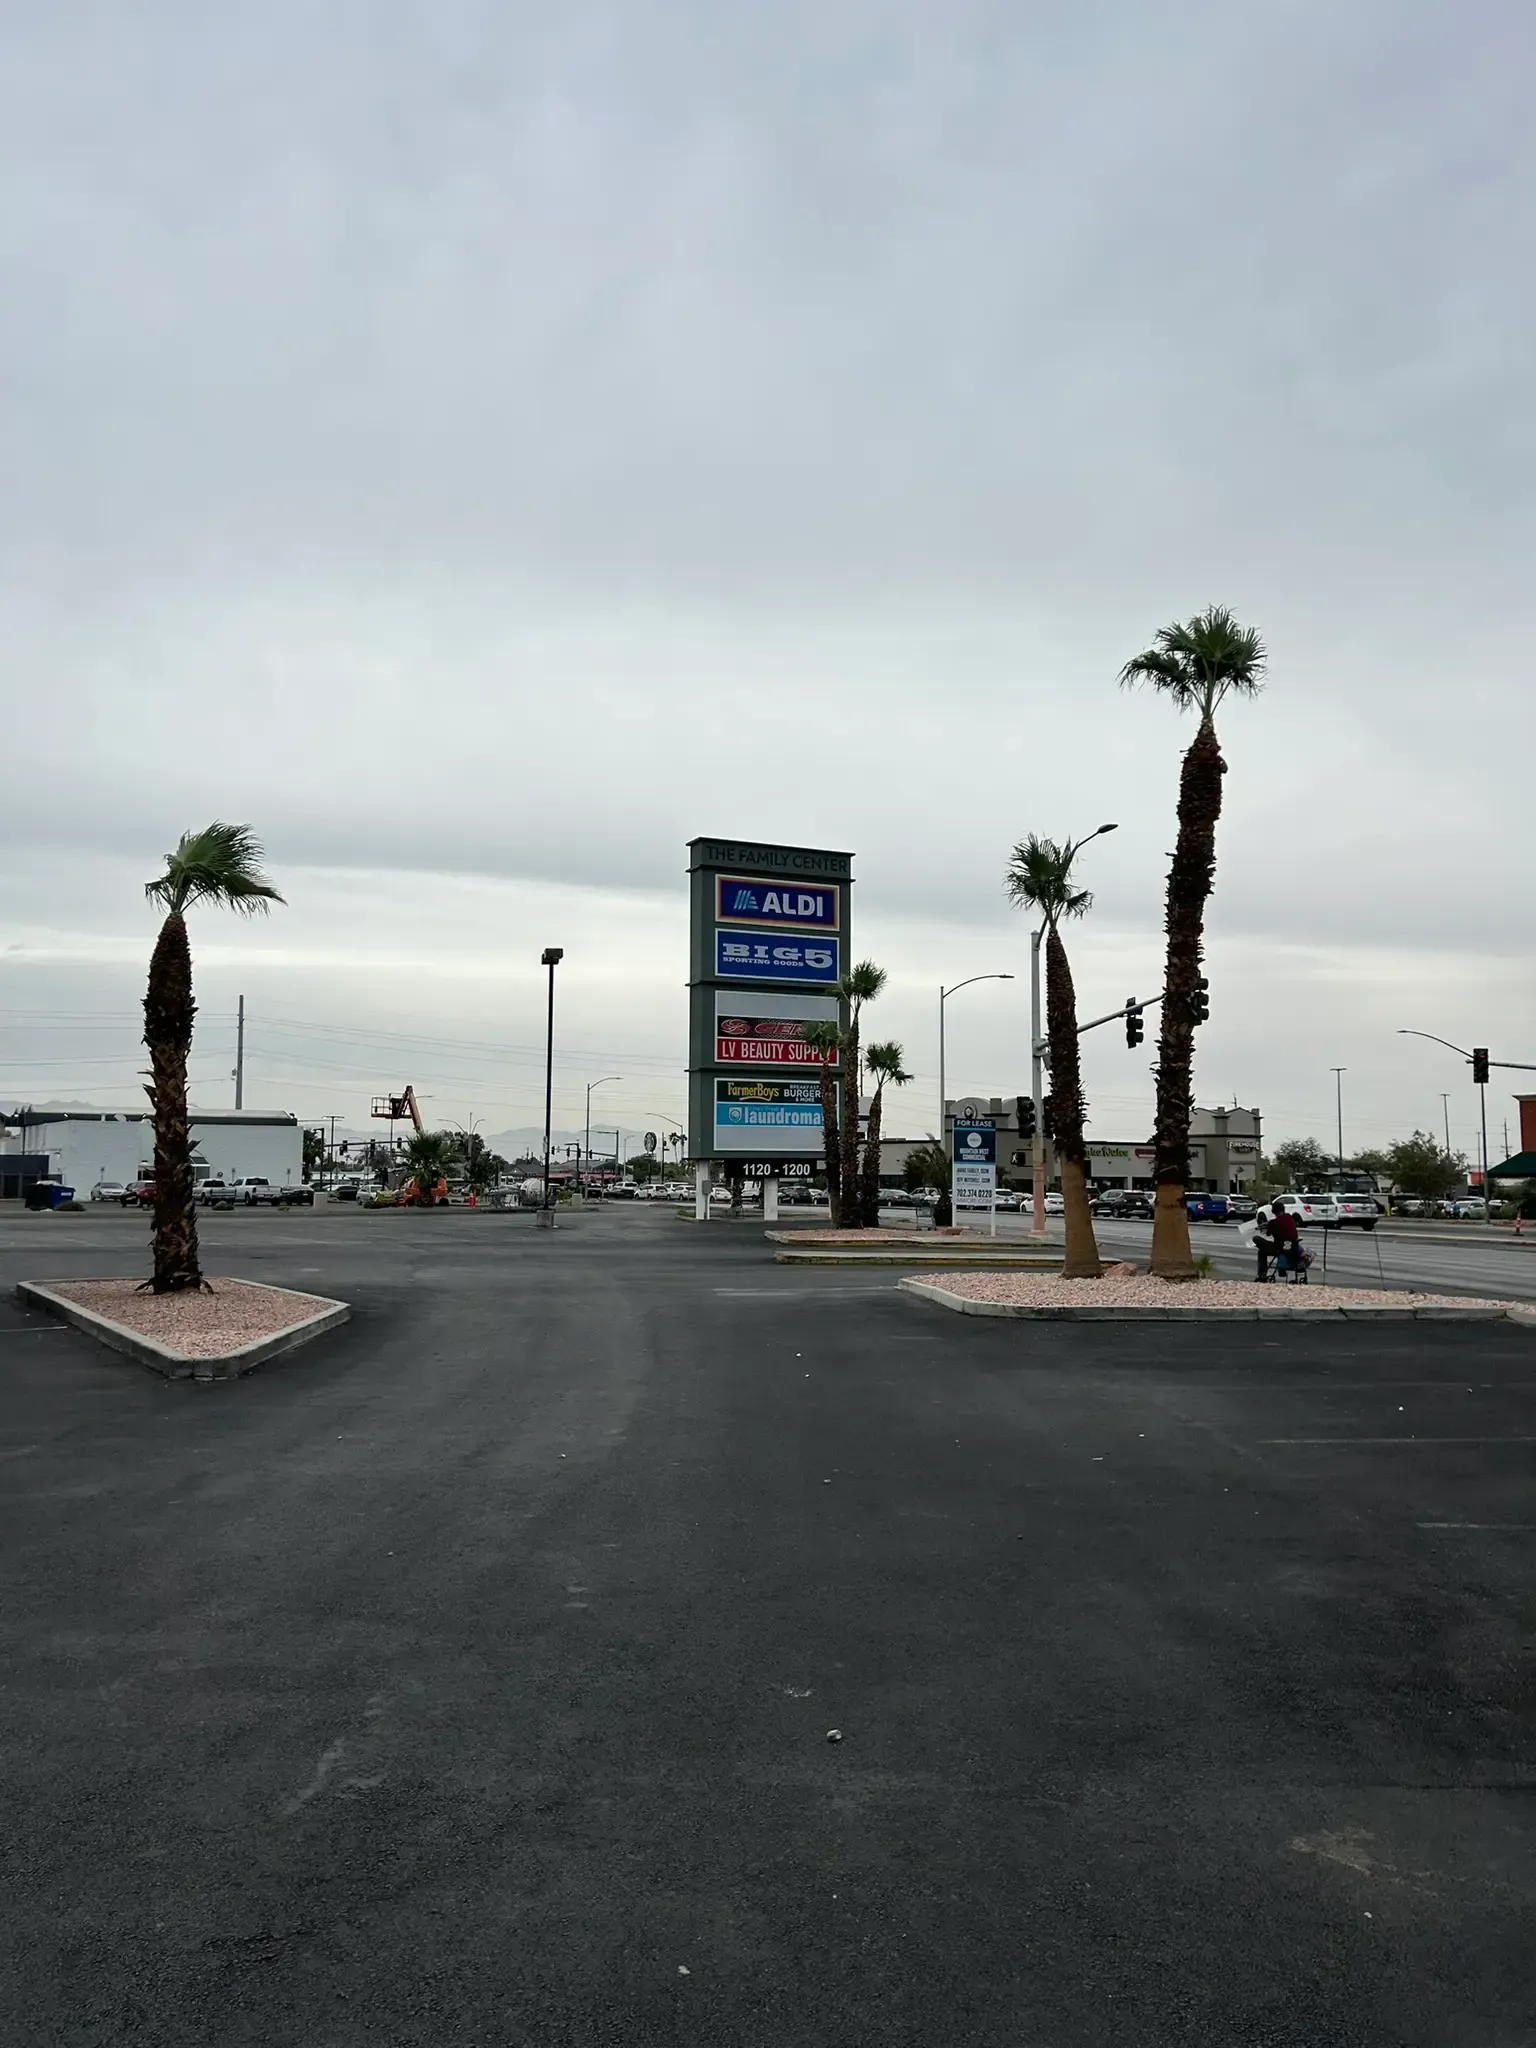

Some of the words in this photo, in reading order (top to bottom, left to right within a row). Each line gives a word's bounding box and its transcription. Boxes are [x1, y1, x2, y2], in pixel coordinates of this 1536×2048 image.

[707, 845, 735, 862] THE
[738, 849, 790, 867] FAMILY
[792, 854, 848, 873] CENTER
[762, 891, 824, 917] ALDI
[722, 943, 802, 960] BIG
[804, 948, 833, 969] 5
[723, 956, 770, 965] SPORTING
[773, 959, 804, 968] GOODS
[721, 1041, 736, 1058] LV
[741, 1042, 784, 1059] BEAUTY
[783, 1089, 824, 1098] BURGER
[744, 1107, 823, 1125] laundroma
[742, 1163, 771, 1176] 1120
[782, 1163, 811, 1176] 1200
